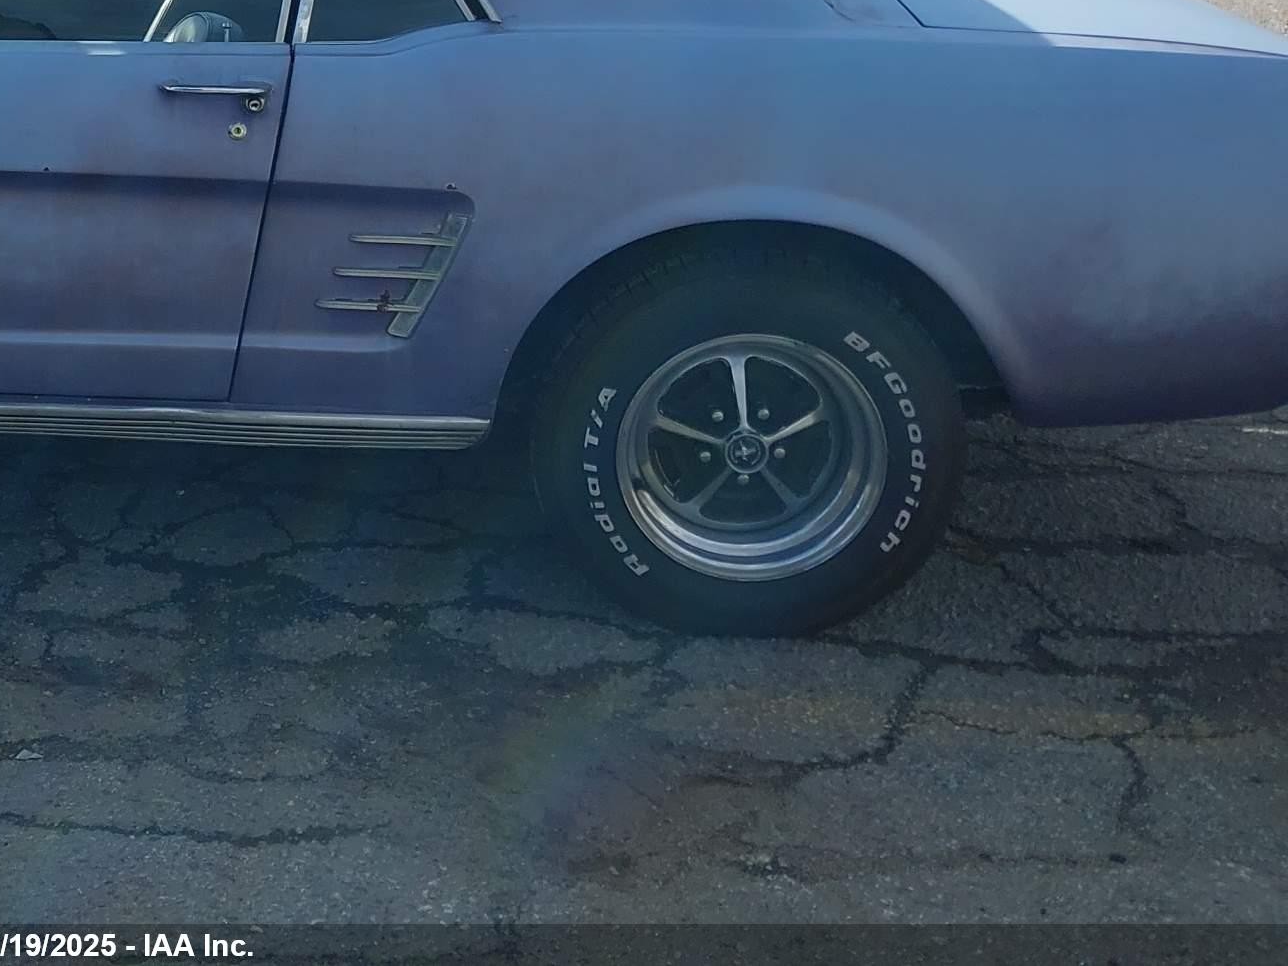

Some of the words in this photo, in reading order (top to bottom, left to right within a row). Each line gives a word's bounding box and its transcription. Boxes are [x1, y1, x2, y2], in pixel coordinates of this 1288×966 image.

[583, 387, 617, 449] T/A
[843, 331, 926, 553] BFGoodrich
[583, 463, 649, 576] Radial
